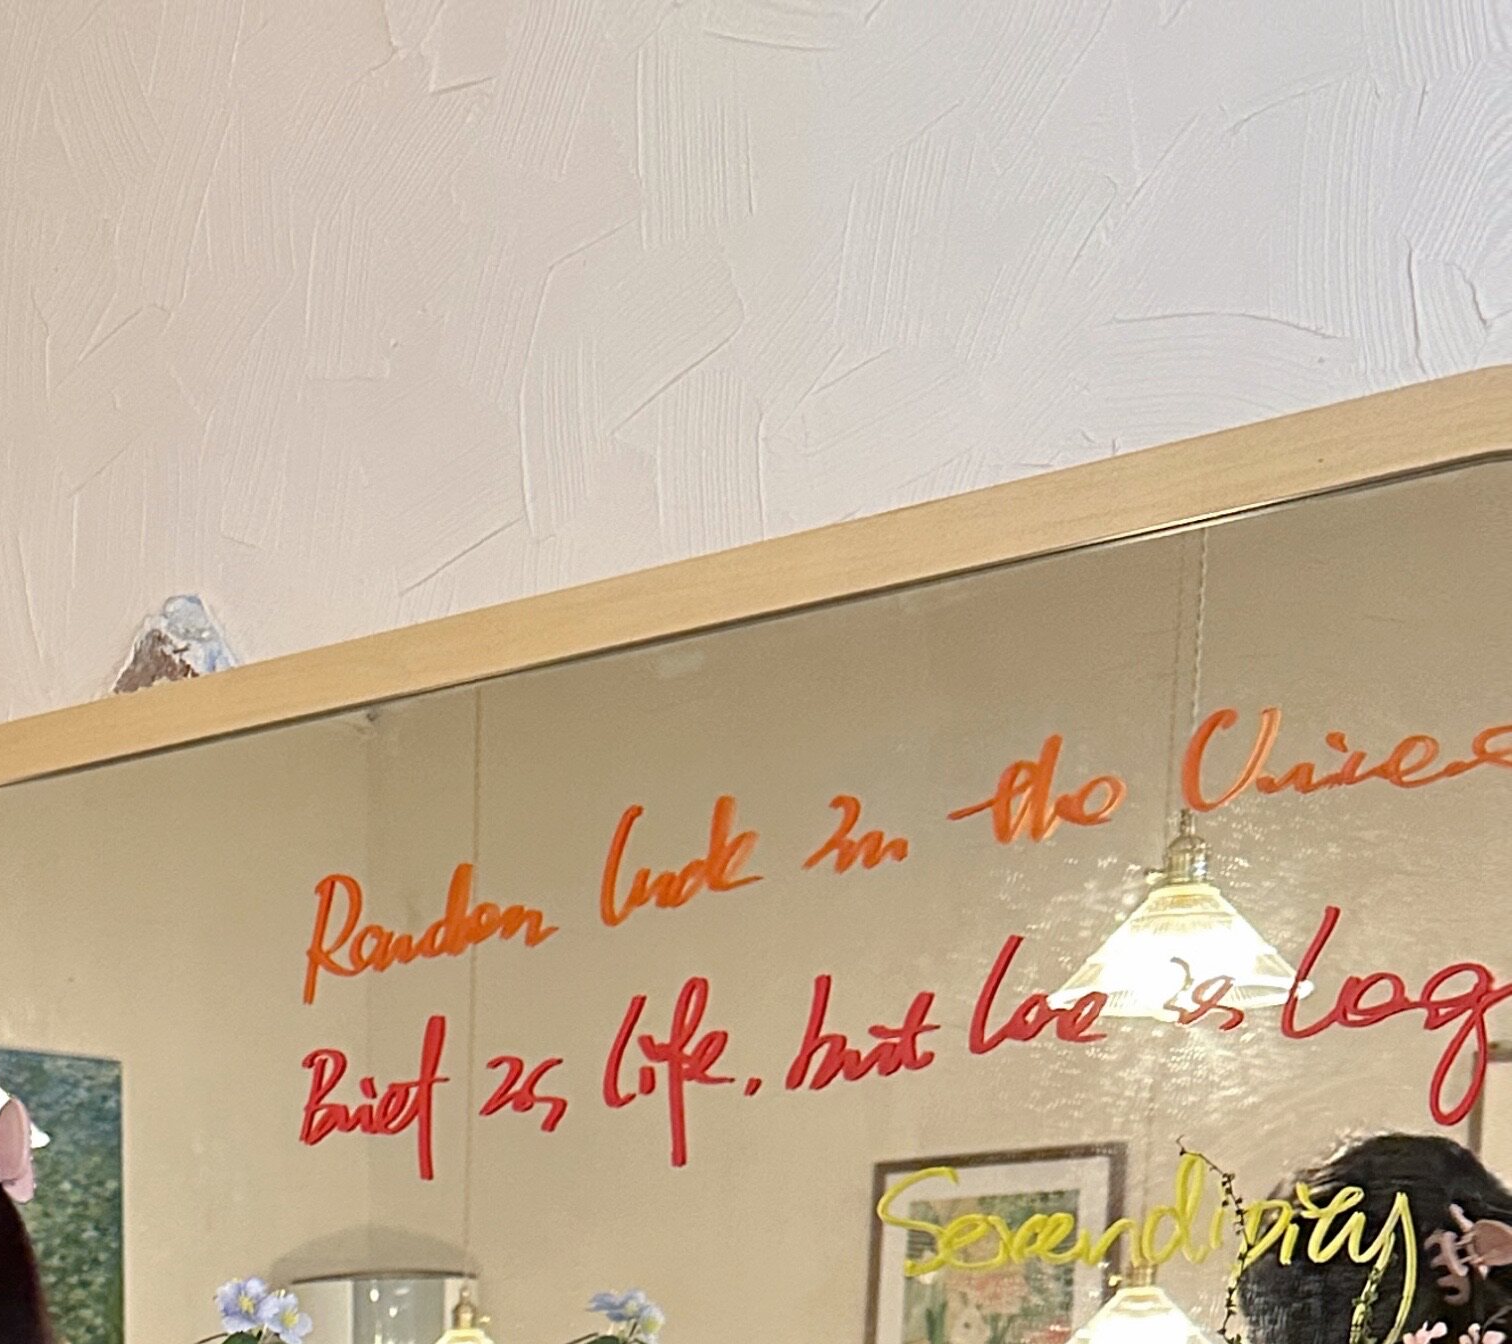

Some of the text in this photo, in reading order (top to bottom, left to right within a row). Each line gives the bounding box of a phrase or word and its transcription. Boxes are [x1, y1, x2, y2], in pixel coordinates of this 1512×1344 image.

[947, 734, 1127, 844] the
[299, 1014, 450, 1181] Brief
[784, 973, 940, 1091] but
